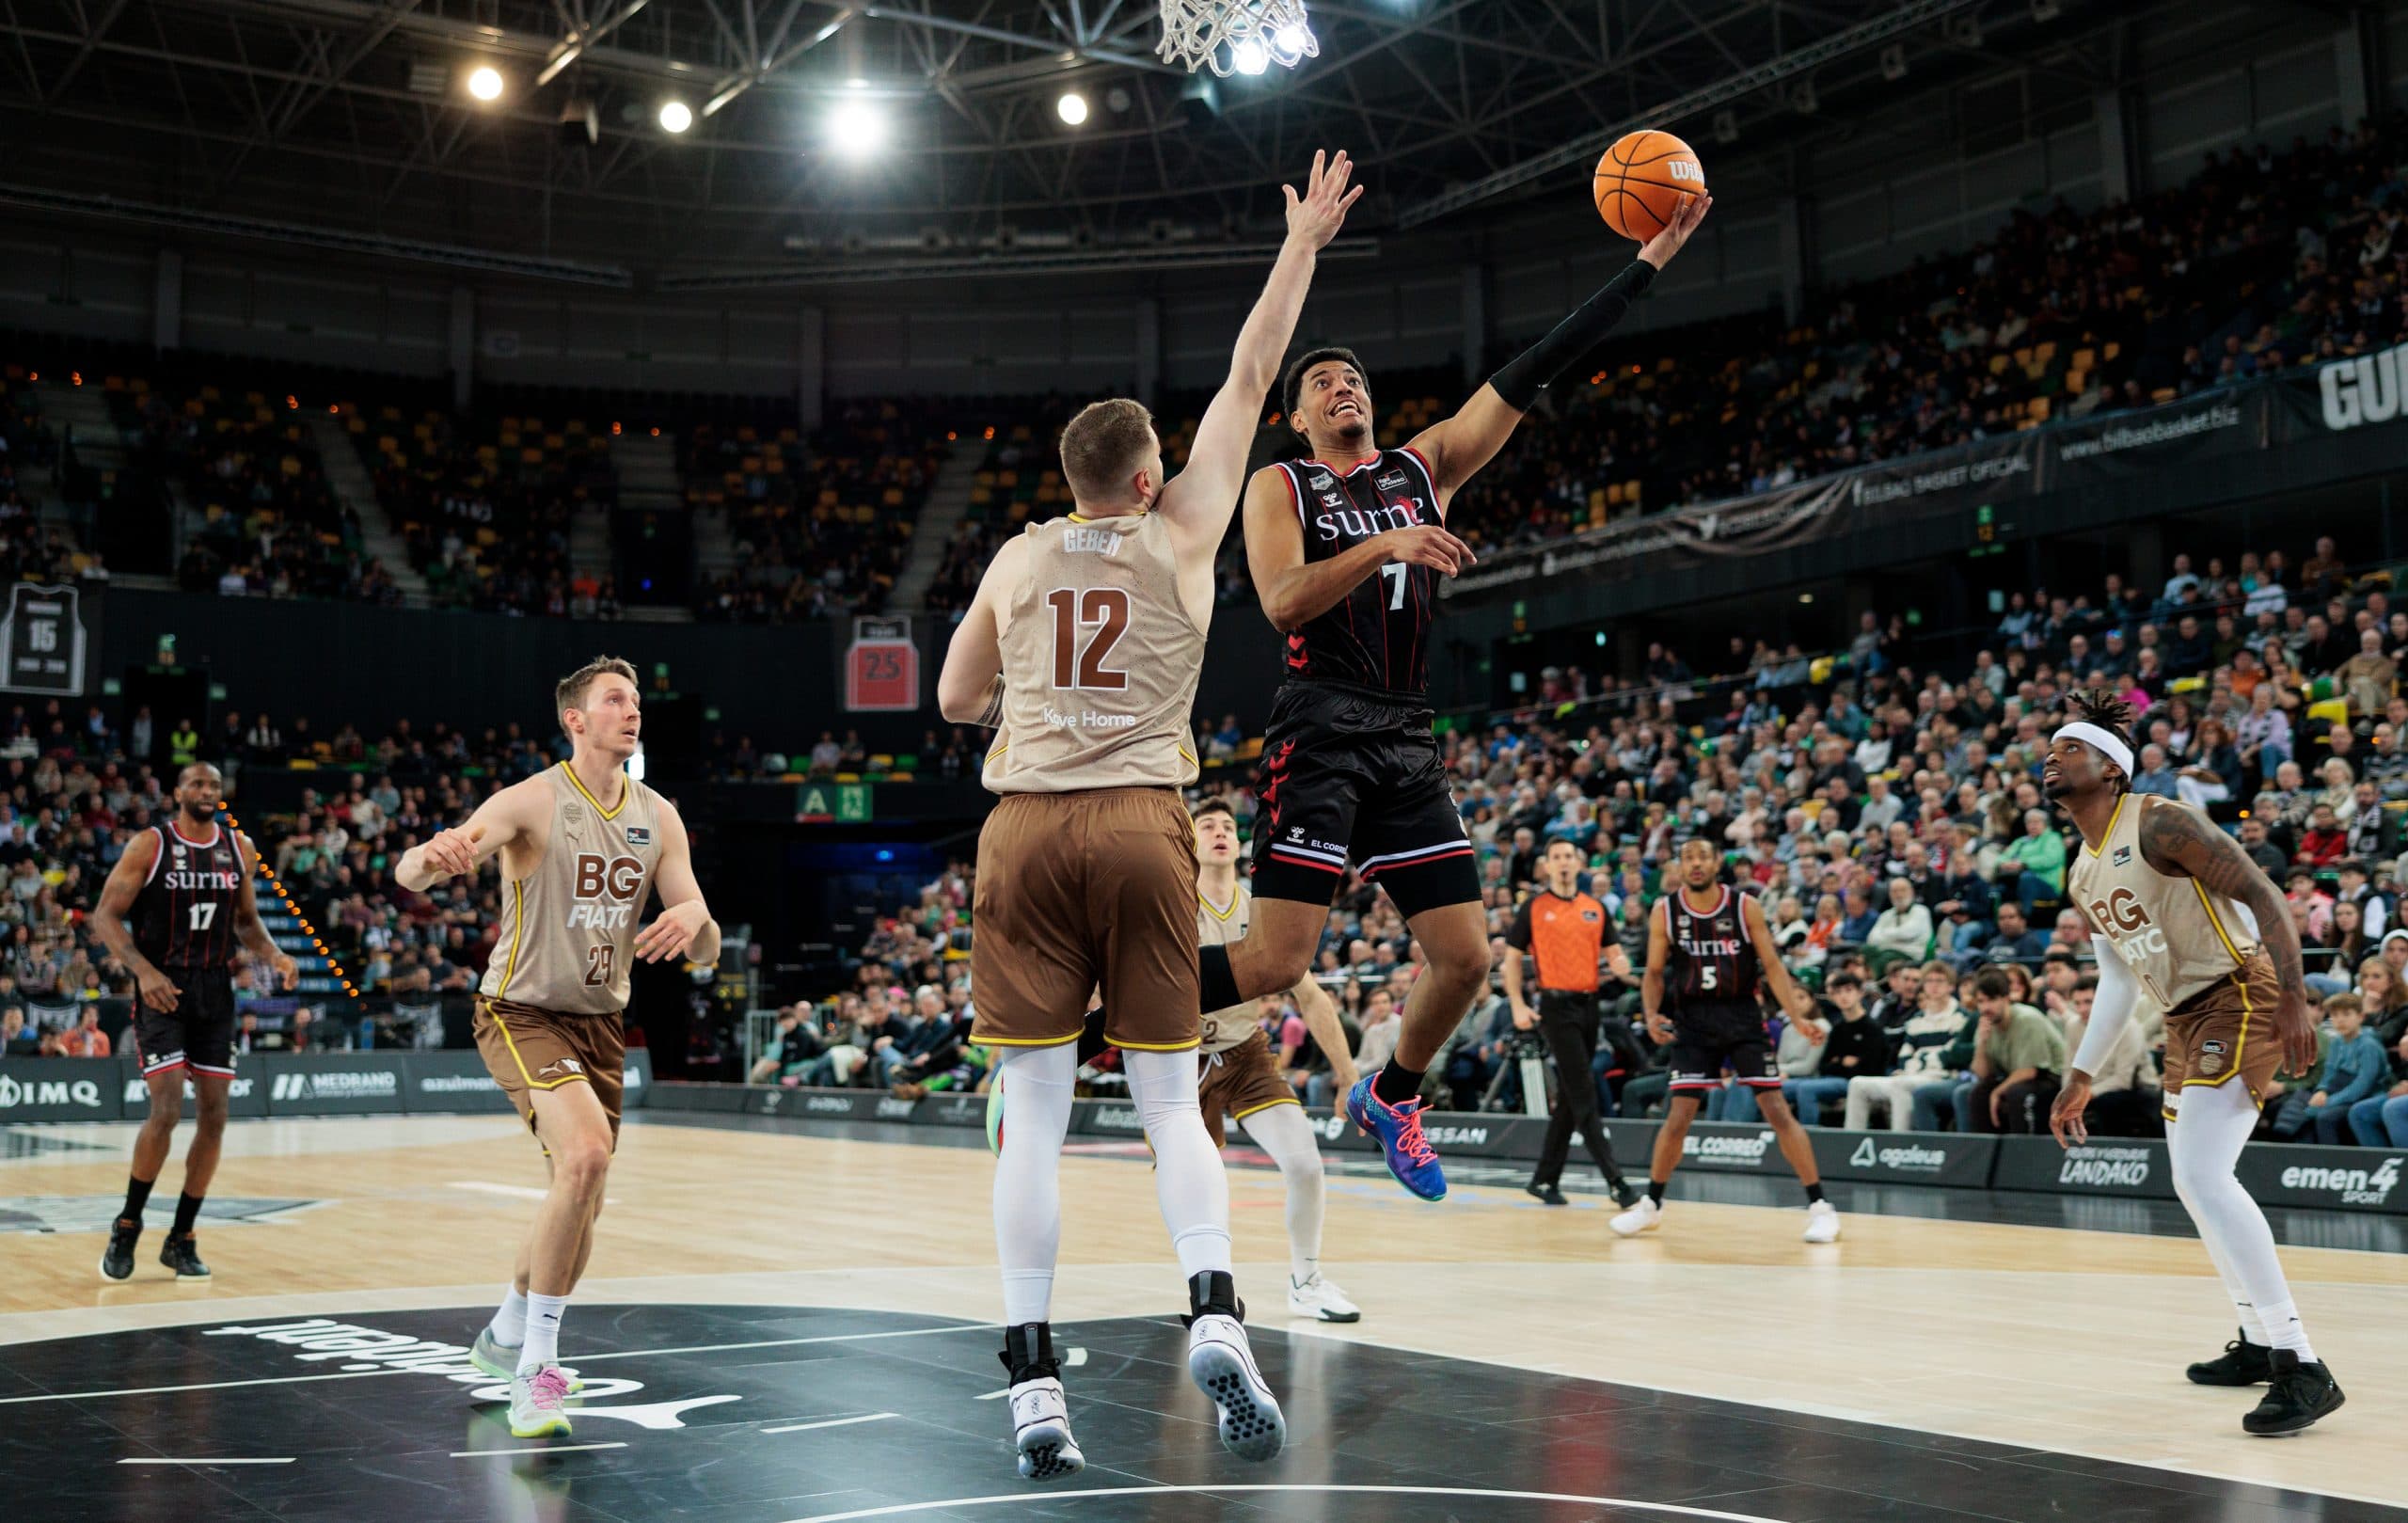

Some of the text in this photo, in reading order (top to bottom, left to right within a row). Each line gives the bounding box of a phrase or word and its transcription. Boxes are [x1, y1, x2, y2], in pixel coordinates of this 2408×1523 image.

[1316, 497, 1424, 541] surne
[1064, 529, 1123, 557] GEBEN
[1381, 563, 1407, 611] 7
[30, 620, 57, 652] 15
[1046, 587, 1131, 690] 12
[863, 650, 901, 680] 25
[1082, 710, 1136, 728] Home
[1311, 839, 1323, 849] EL
[165, 871, 240, 890] surne
[574, 851, 645, 902] BG
[189, 902, 217, 930] 17
[566, 904, 633, 929] FIATC
[2090, 886, 2152, 942] BG
[2122, 928, 2168, 965] ATC
[584, 944, 615, 987] 29
[1701, 965, 1718, 990] 5
[23, 1080, 102, 1107] IMQ
[1423, 1126, 1488, 1144] ISSAN
[2058, 1159, 2149, 1185] LANDAKO
[2341, 1190, 2387, 1205] SPORT
